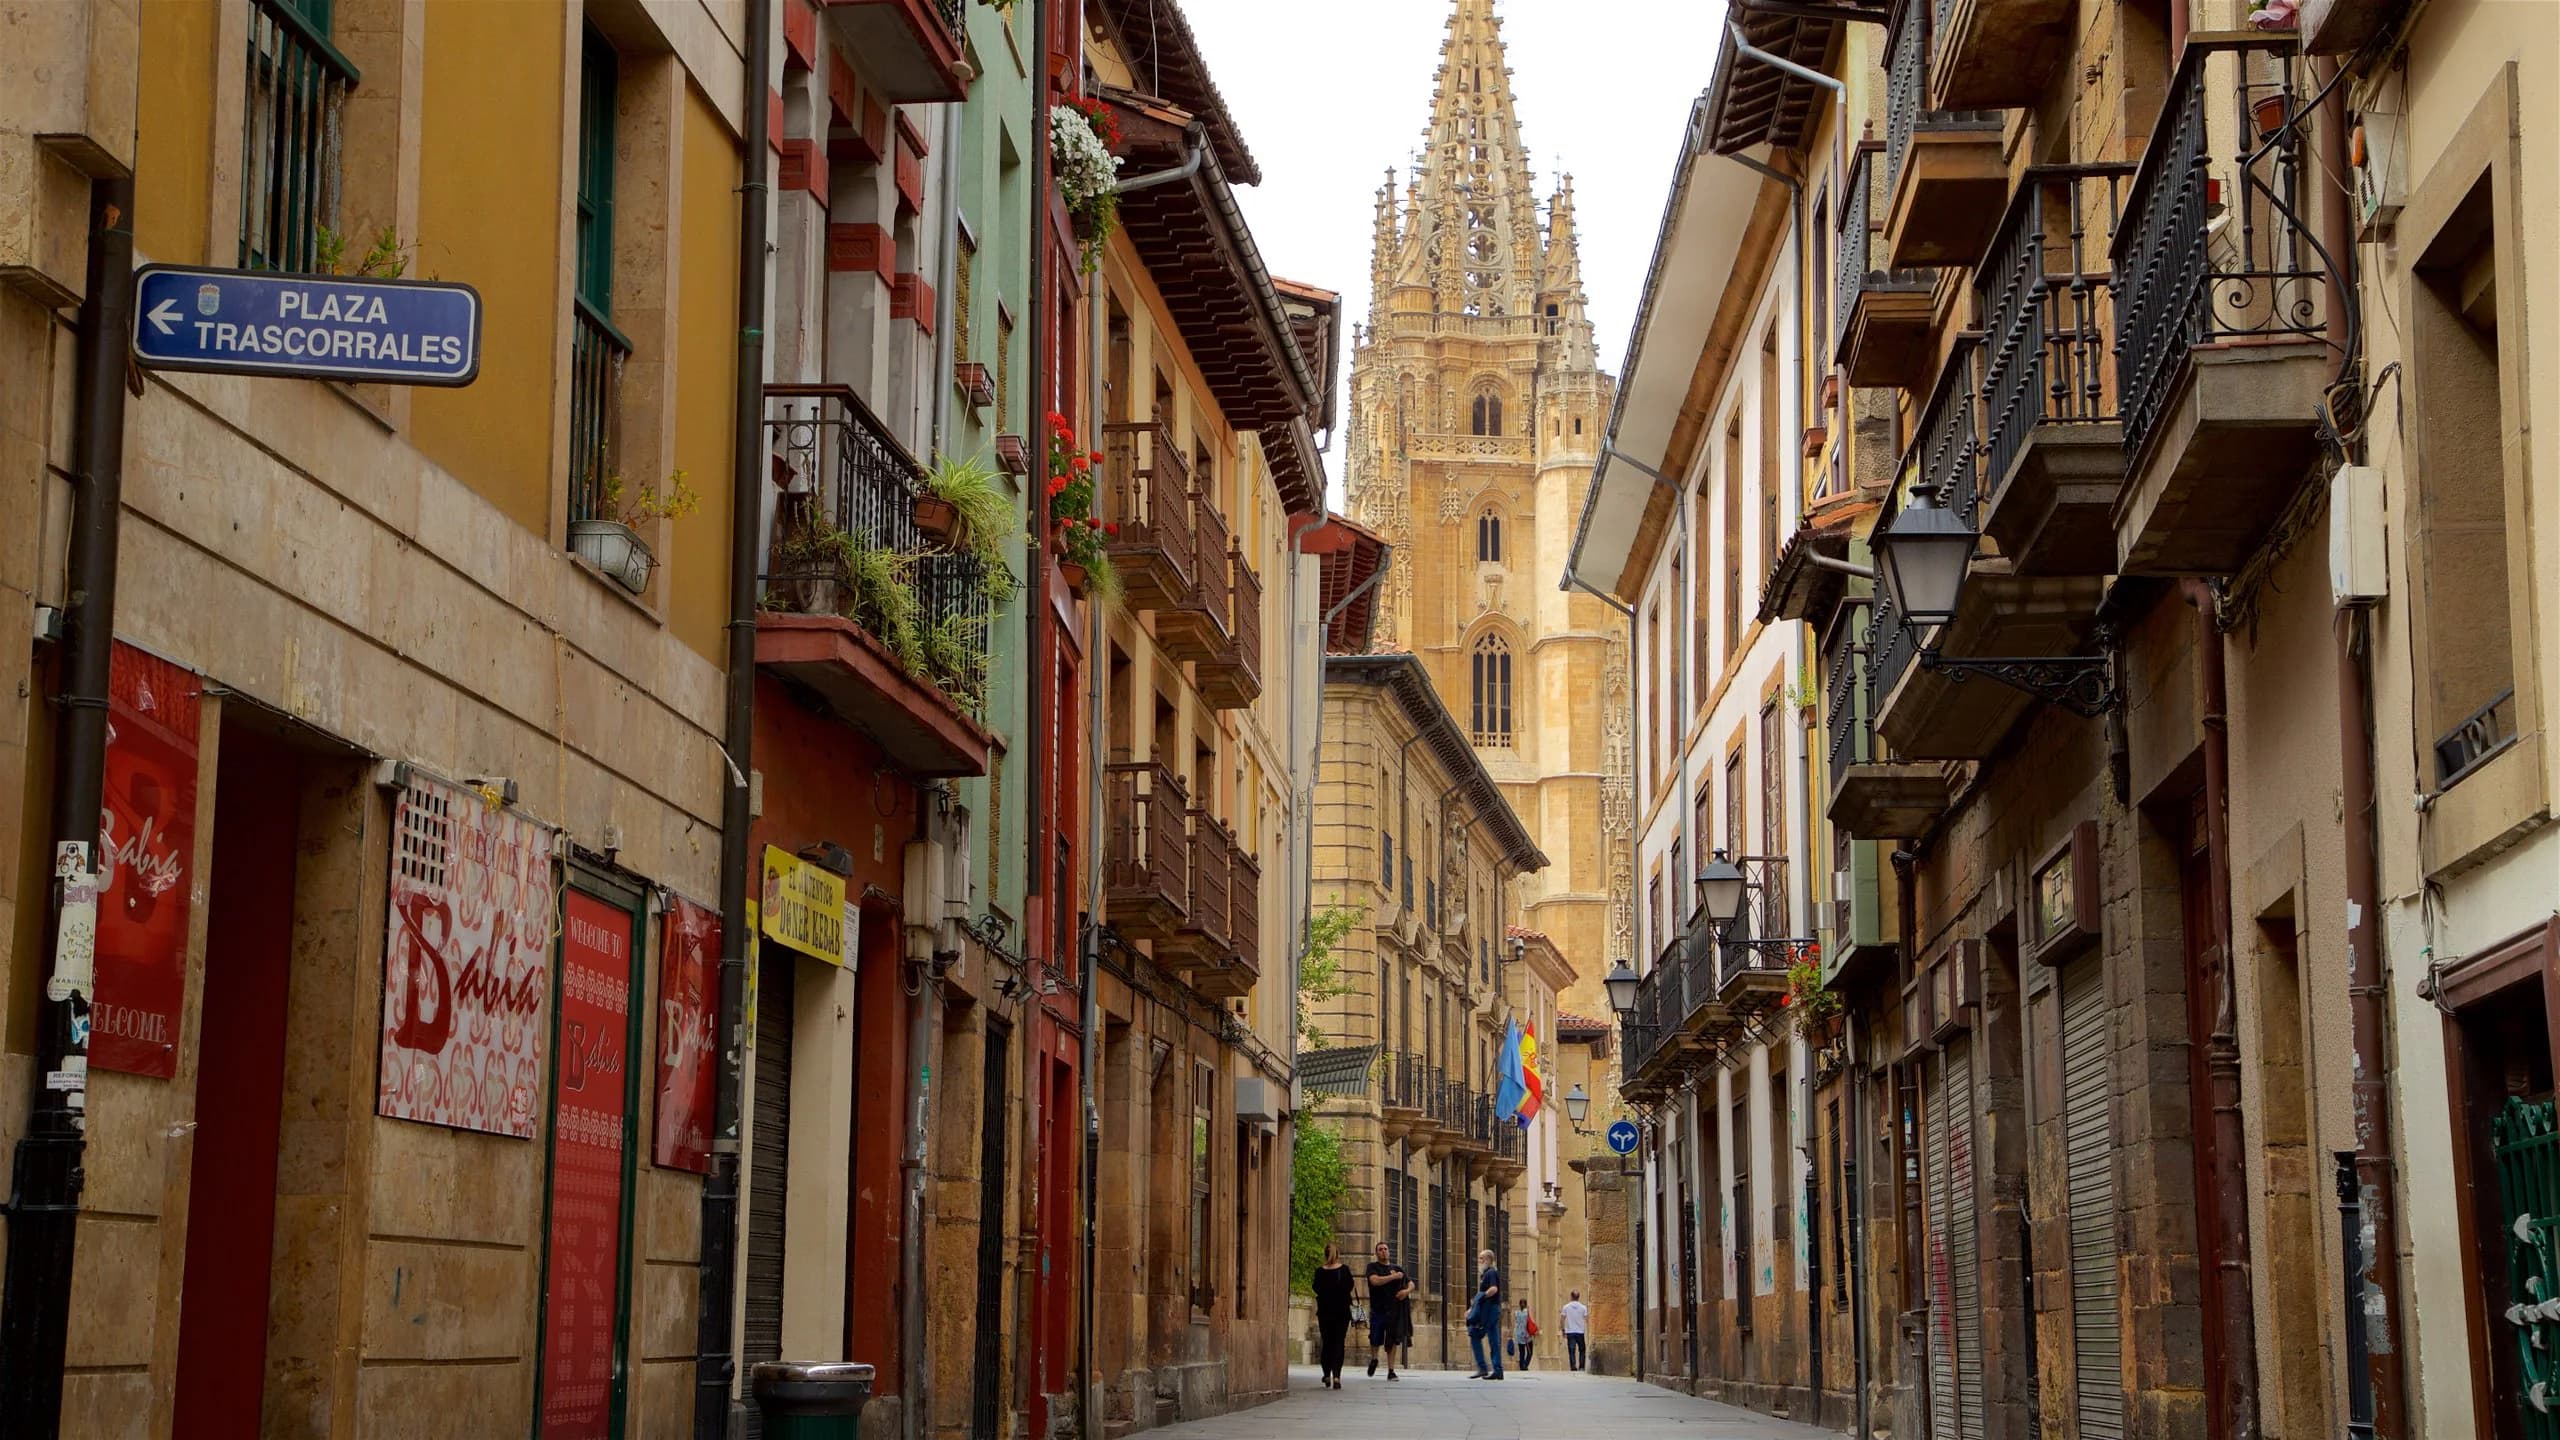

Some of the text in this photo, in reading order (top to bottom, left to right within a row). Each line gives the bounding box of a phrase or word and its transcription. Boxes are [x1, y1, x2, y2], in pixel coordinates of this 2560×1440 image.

[279, 291, 388, 325] PLAZA
[194, 321, 462, 365] TRASCORRALES
[570, 916, 623, 960] WELCOME TO
[812, 910, 840, 957] KEBAB
[394, 894, 541, 1055] Babia
[87, 1001, 167, 1044] ELCOME
